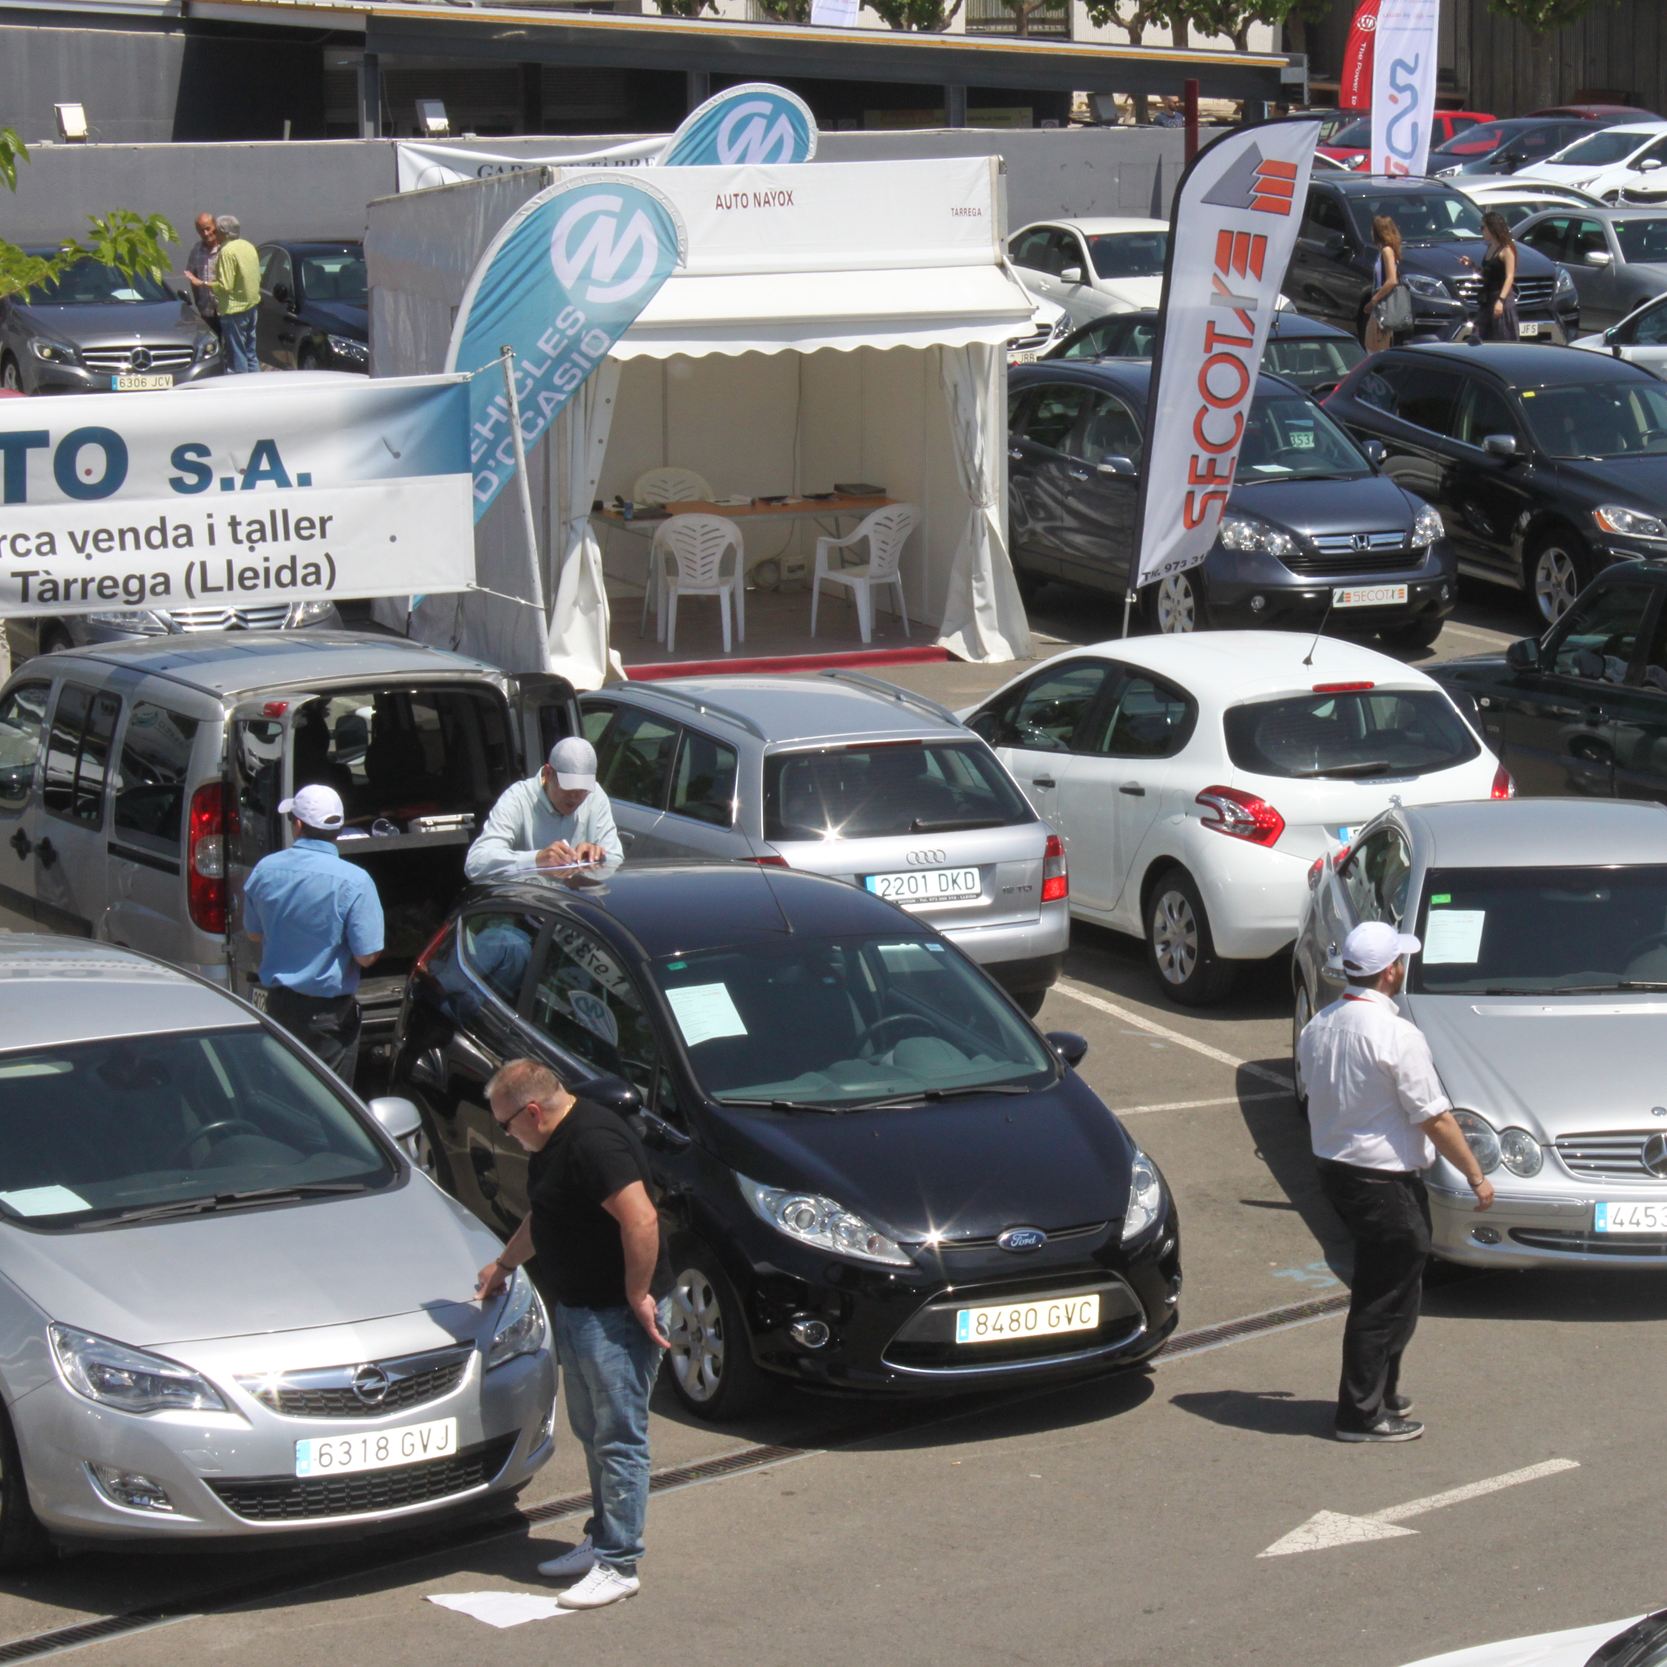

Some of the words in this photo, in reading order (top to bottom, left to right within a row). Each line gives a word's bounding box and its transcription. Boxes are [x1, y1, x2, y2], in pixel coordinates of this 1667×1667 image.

[715, 192, 749, 210] AUTO
[753, 190, 794, 208] NAYOX
[119, 378, 147, 388] 6306
[151, 376, 171, 387] JCV
[471, 305, 586, 464] EHICLES
[168, 438, 313, 494] S.A.
[68, 516, 194, 554] venda
[206, 513, 216, 546] i
[228, 508, 334, 545] taller
[11, 569, 171, 605] Tàrrega
[184, 552, 337, 600] (Lleida)
[881, 875, 928, 897] 2201
[938, 871, 975, 892] DKD
[1010, 1232, 1038, 1247] Ford
[975, 1307, 1038, 1335] 8480
[1048, 1301, 1092, 1328] GVC
[318, 1436, 389, 1468] 6318
[401, 1424, 449, 1457] GVJ
